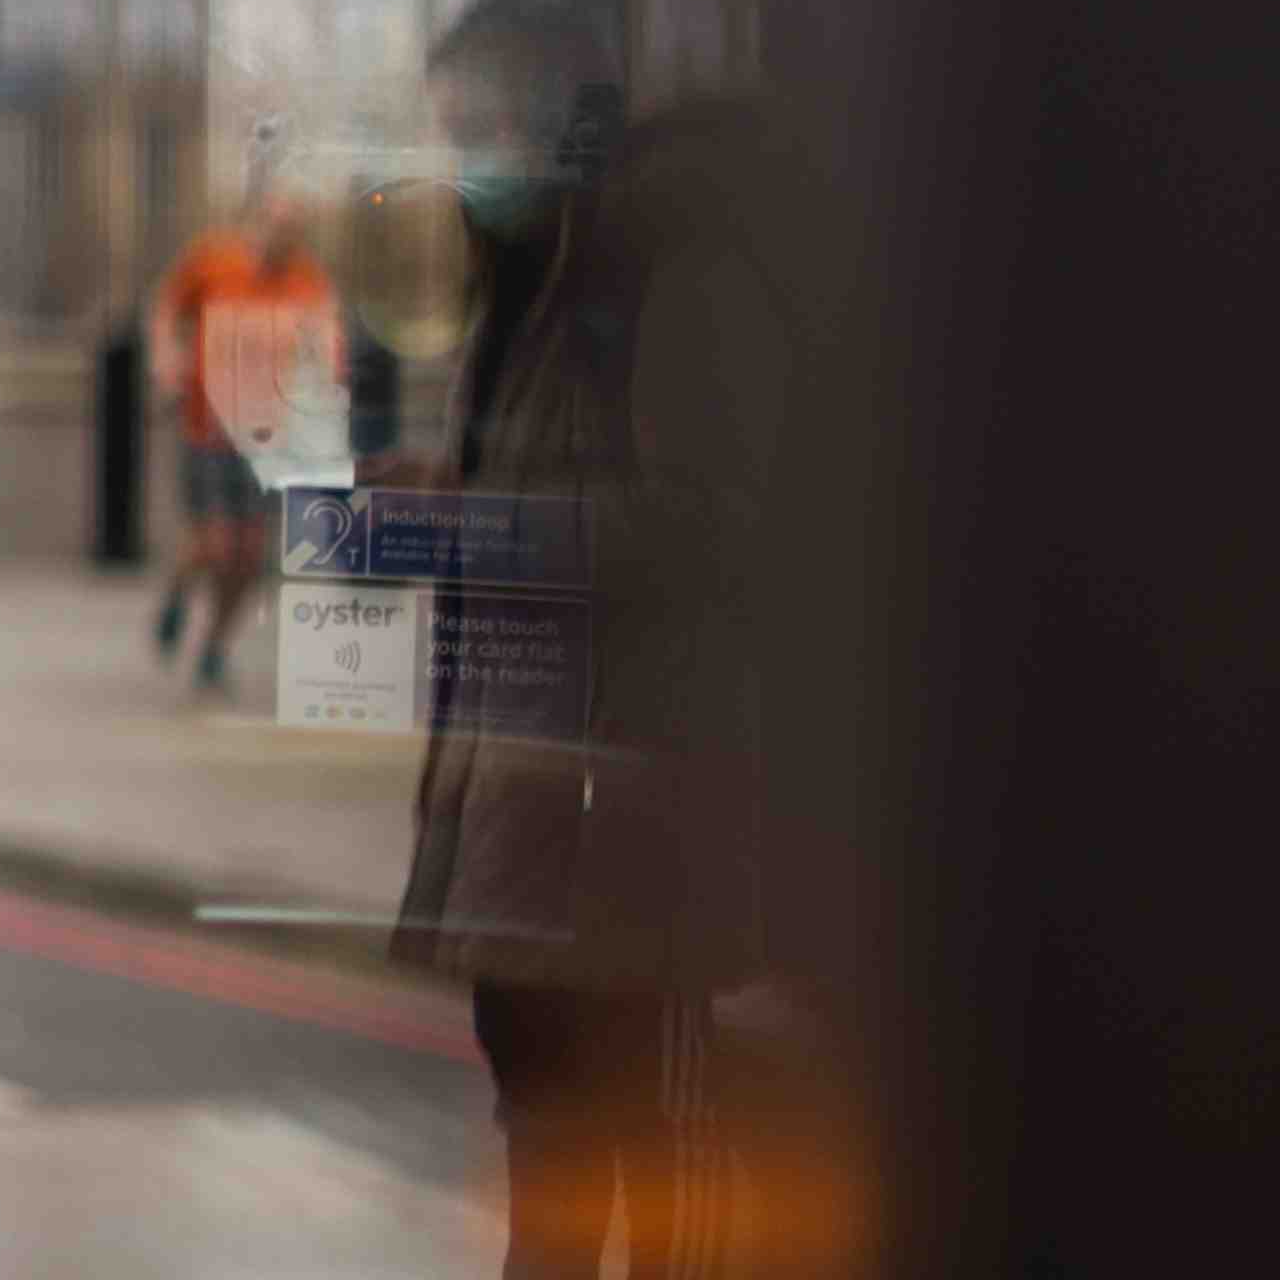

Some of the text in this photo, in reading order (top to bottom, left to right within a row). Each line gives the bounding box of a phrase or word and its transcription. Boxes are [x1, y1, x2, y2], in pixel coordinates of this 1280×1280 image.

[383, 509, 464, 528] Induction
[347, 547, 358, 566] T
[292, 596, 399, 631] oyster
[427, 611, 559, 636] Please touch
[426, 641, 472, 662] your
[477, 638, 521, 658] card
[425, 666, 452, 680] on
[459, 663, 492, 682] the
